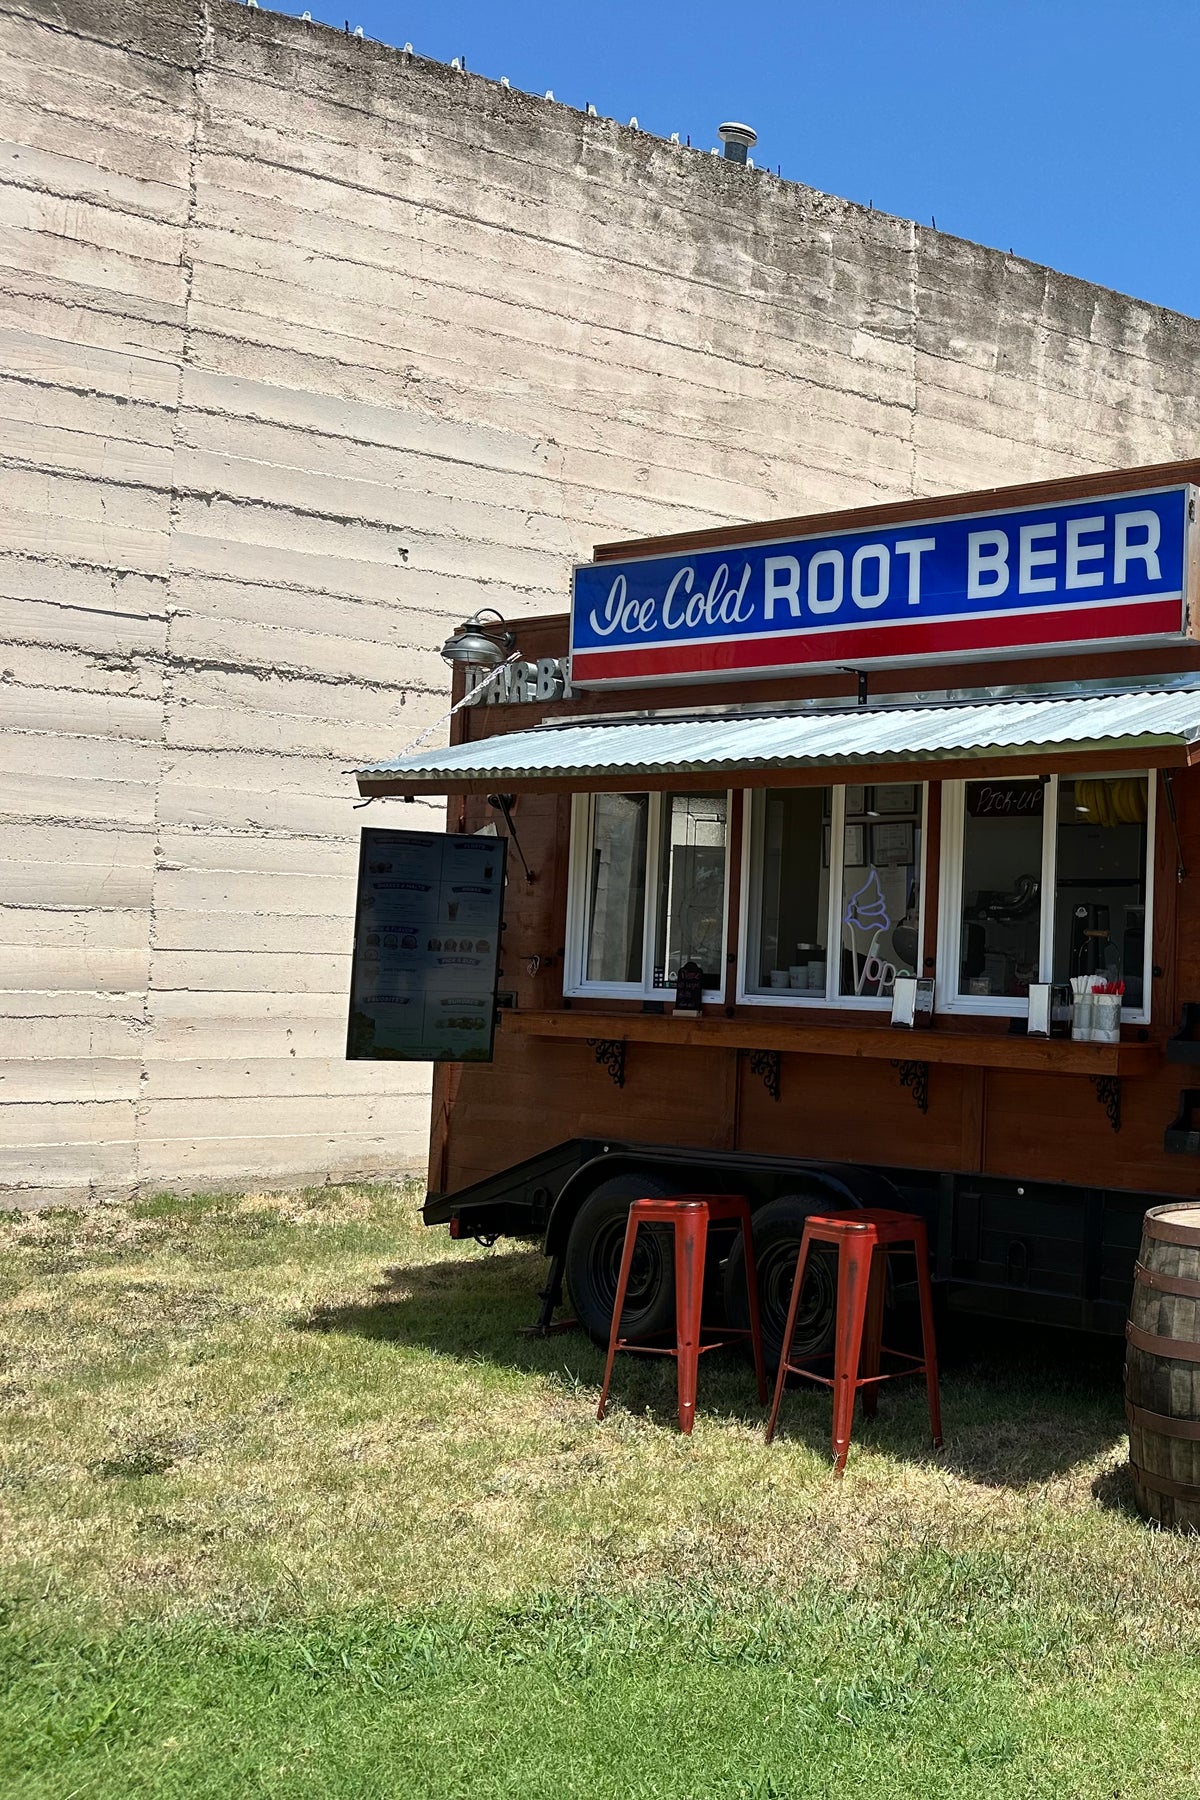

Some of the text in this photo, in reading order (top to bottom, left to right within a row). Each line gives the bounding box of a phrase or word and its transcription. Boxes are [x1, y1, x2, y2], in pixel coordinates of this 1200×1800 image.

[589, 509, 1162, 636] Ice Cold ROOT BEER
[976, 787, 1043, 813] PICK-UP
